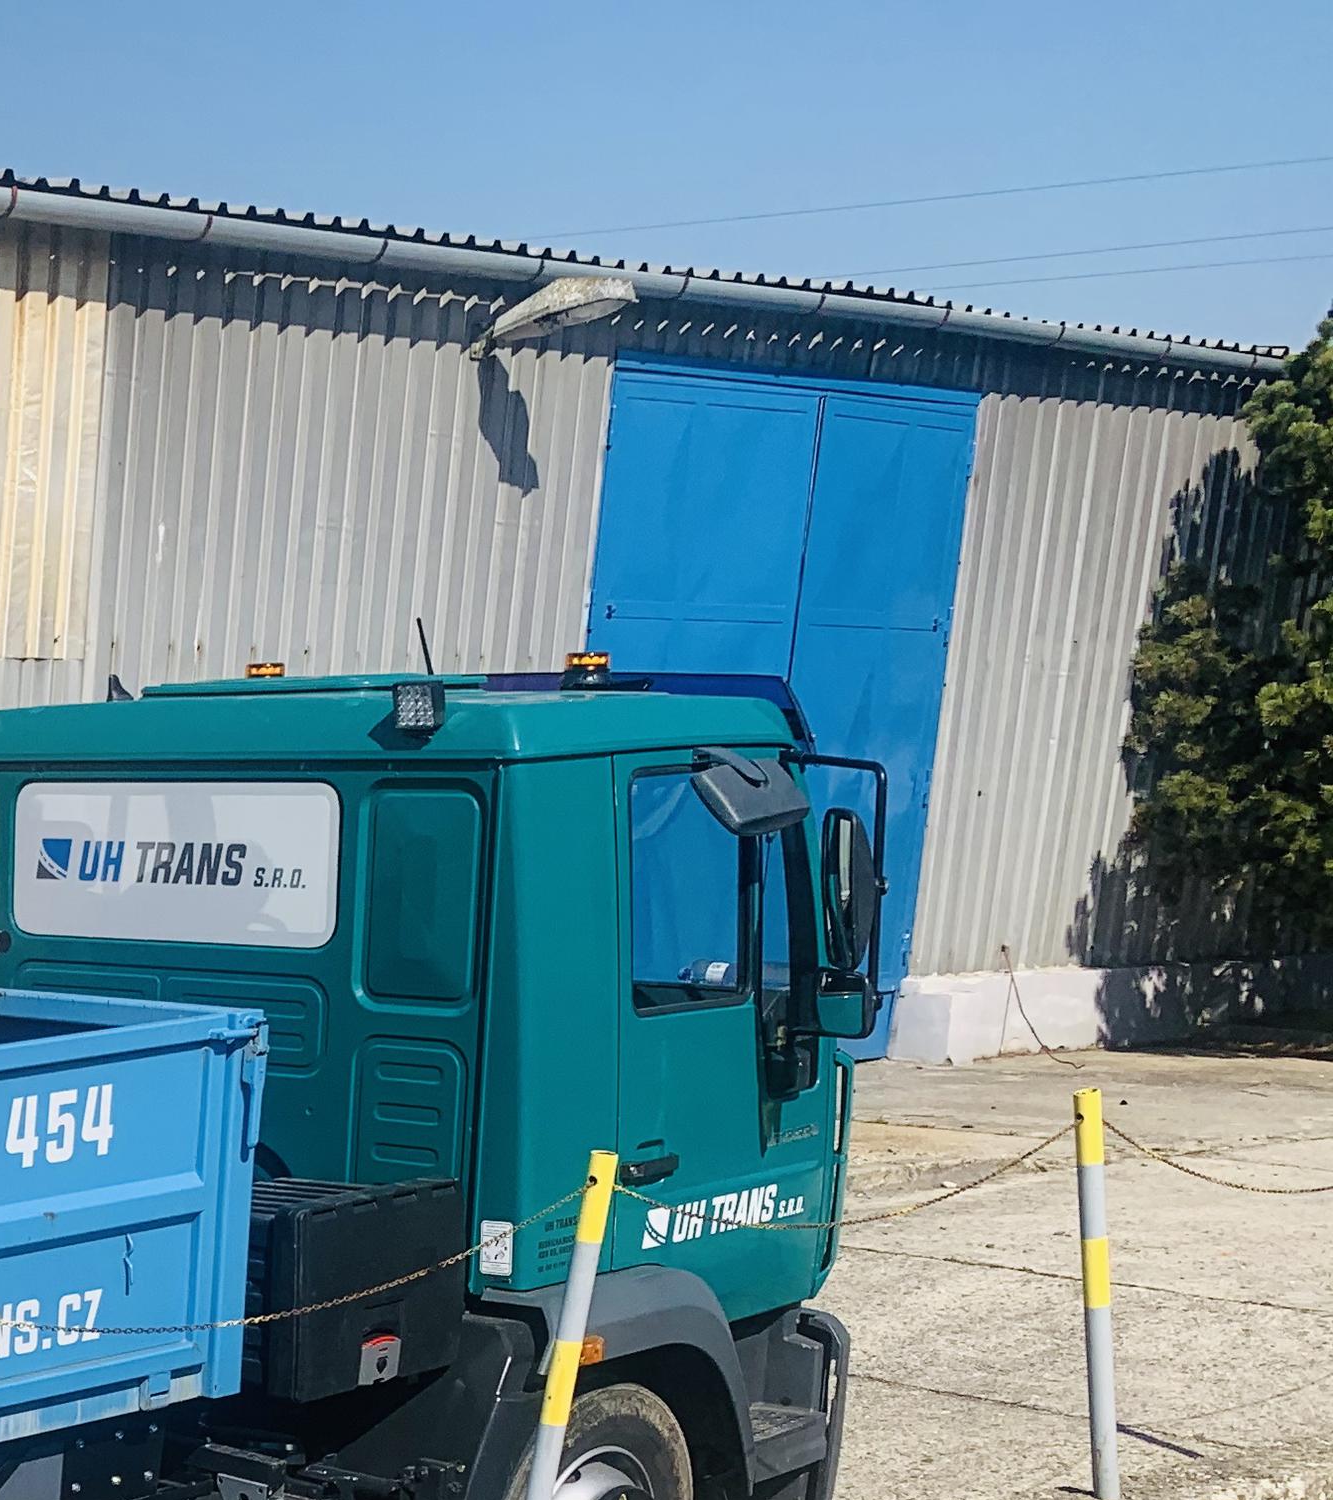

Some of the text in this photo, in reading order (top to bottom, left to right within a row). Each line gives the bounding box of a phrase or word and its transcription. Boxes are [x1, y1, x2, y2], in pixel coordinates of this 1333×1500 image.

[78, 840, 306, 889] UH TRANS S.R.O.
[5, 1083, 113, 1168] 454
[672, 1200, 707, 1243] UH
[710, 1183, 778, 1235] TRANS
